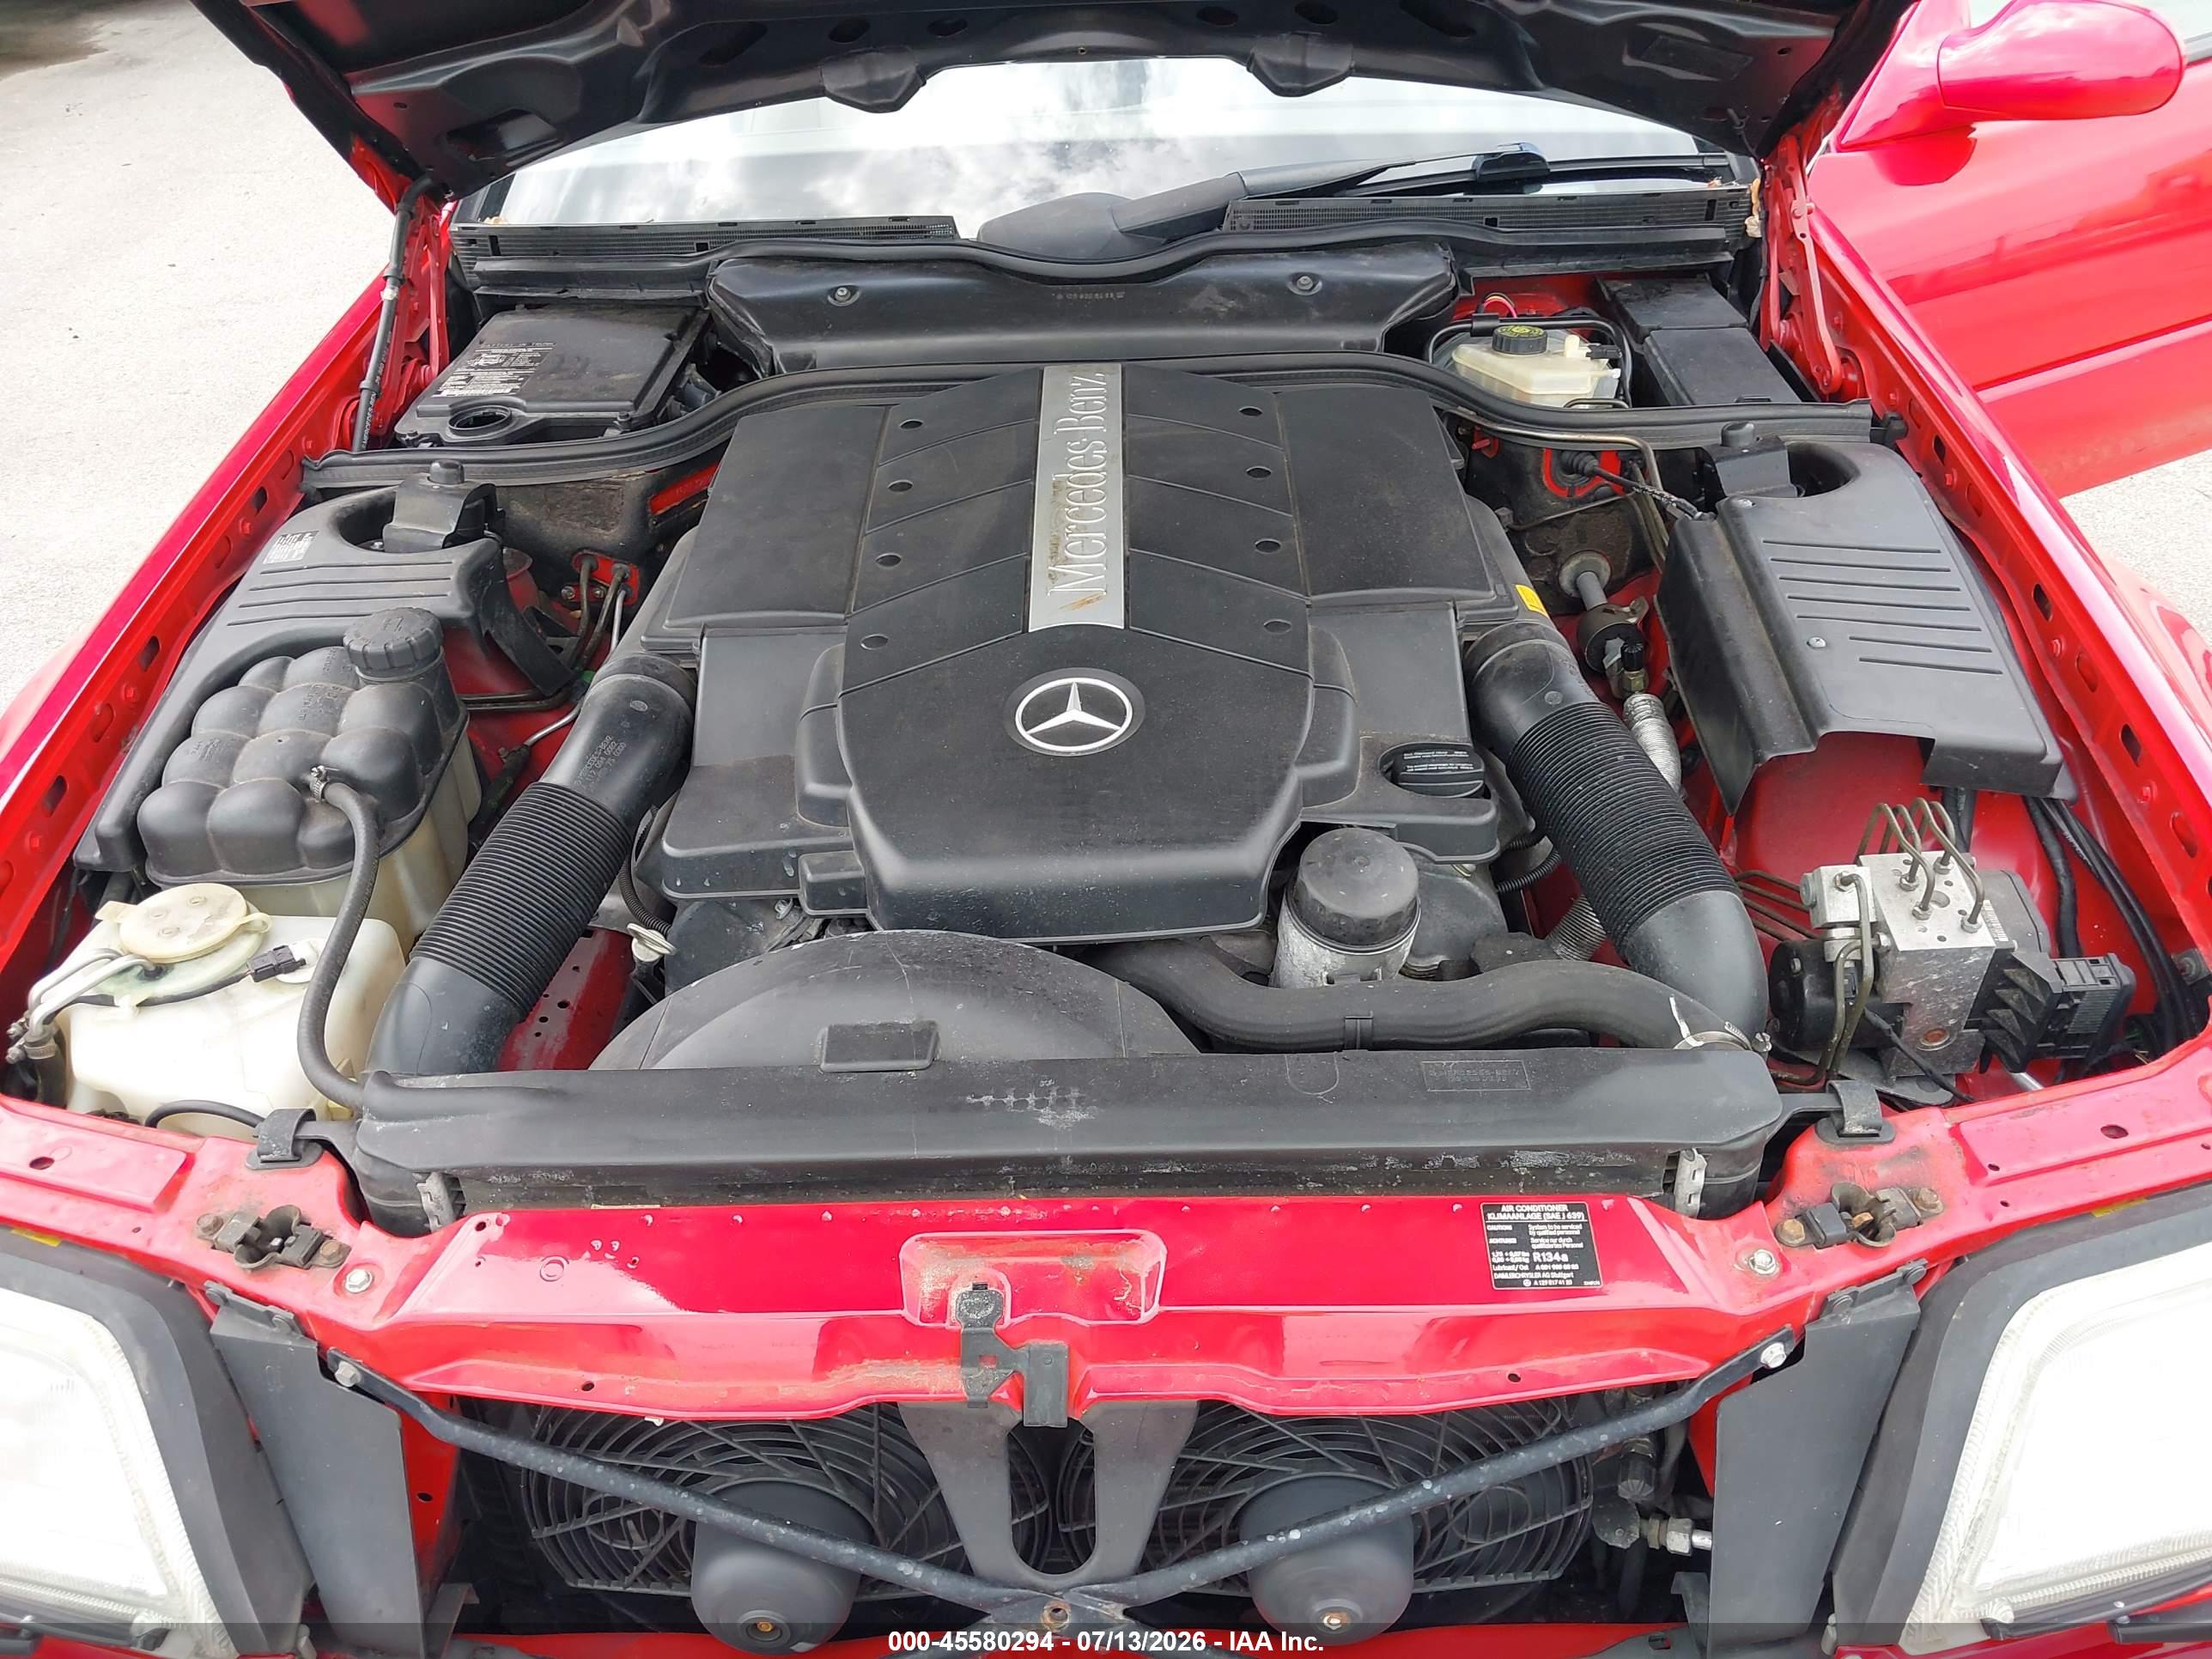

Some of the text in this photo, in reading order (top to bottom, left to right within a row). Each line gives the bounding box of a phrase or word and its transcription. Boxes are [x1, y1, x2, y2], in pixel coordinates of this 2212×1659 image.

[1048, 373, 1107, 596] Mercedes Benz
[1543, 1212, 1561, 1220] (SAE
[1566, 1212, 1584, 1220] 639)
[1533, 1252, 1569, 1262] R134a
